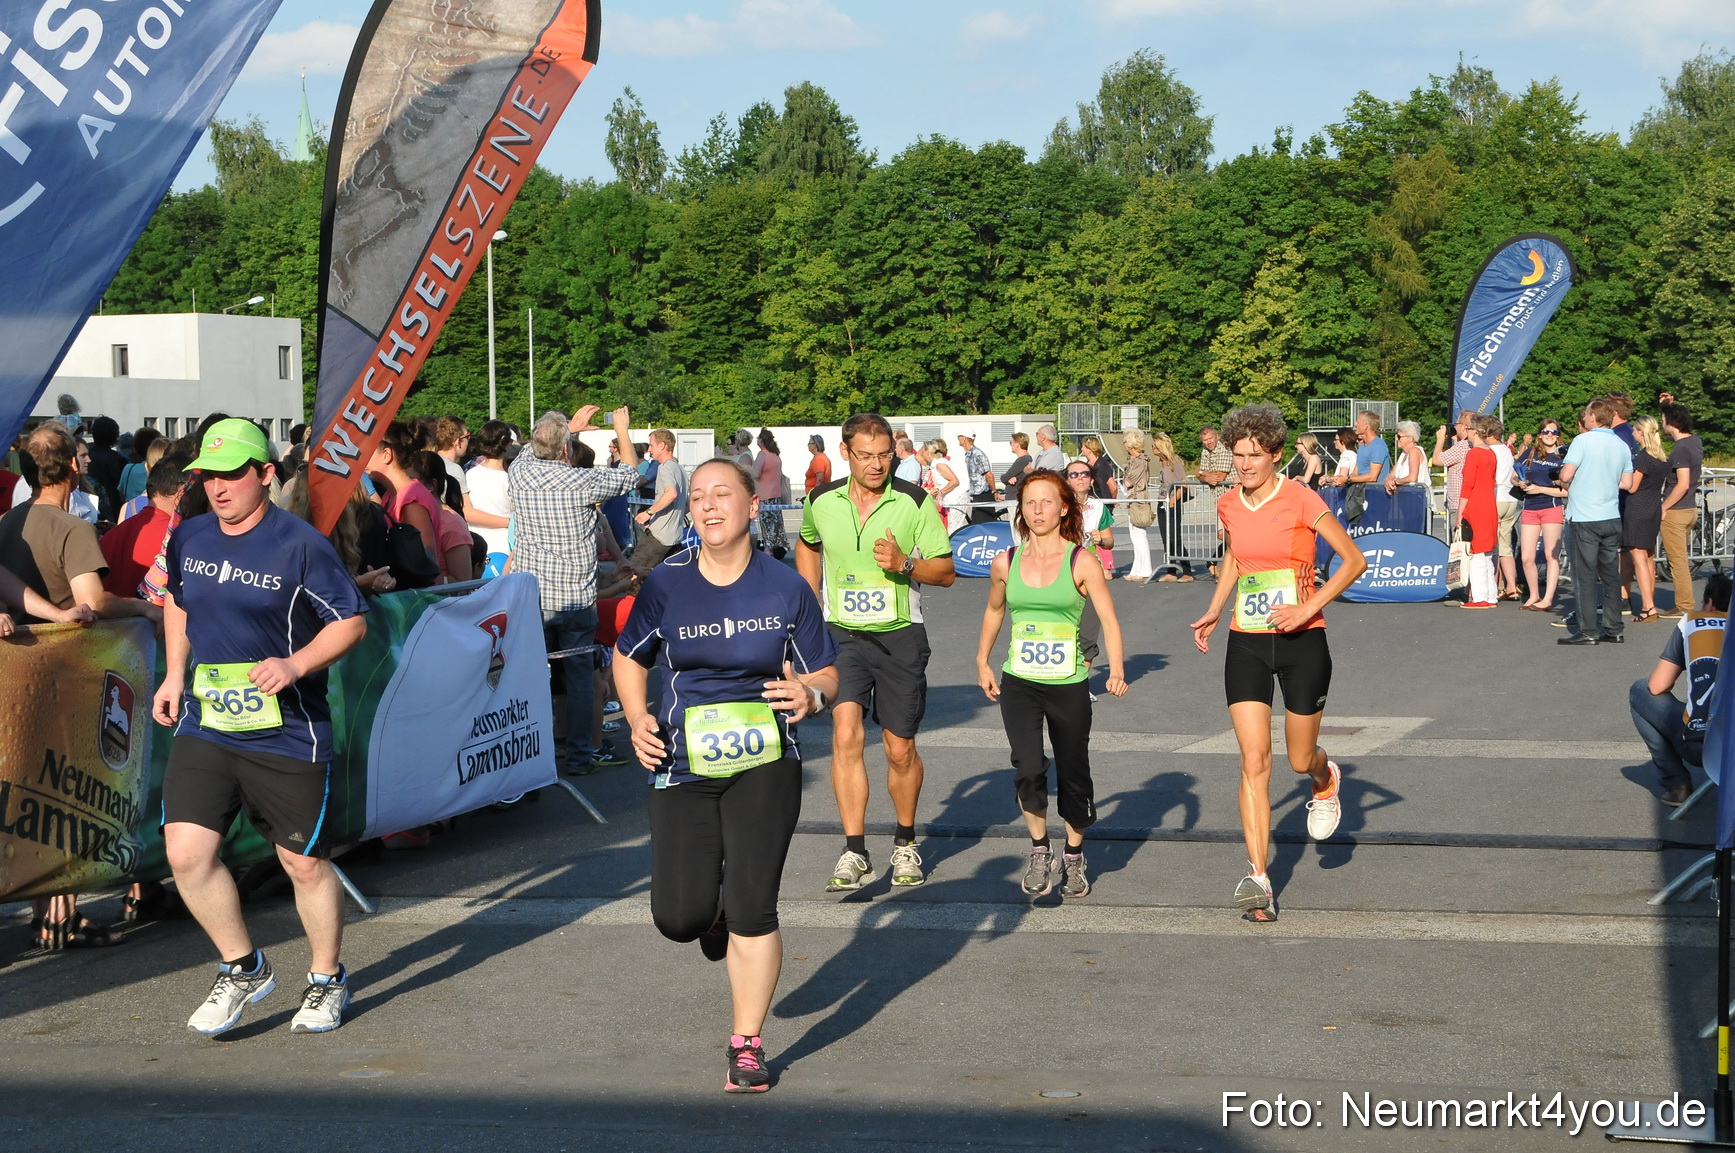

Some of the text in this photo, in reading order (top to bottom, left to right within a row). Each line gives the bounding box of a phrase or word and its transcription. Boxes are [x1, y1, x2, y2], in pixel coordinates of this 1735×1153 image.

[1515, 306, 1535, 329] Druck
[1460, 287, 1540, 387] Frischmann
[183, 557, 282, 590] EURO POLES
[1362, 562, 1443, 579] Fischer
[1369, 578, 1437, 587] AUTOMOBILE
[843, 590, 886, 613] 583
[1244, 590, 1284, 616] 584
[679, 616, 782, 640] EURO POLES
[1020, 642, 1065, 665] 585
[205, 687, 264, 715] 365
[468, 698, 529, 740] eumarkter
[457, 724, 540, 786] Lammsbräu
[701, 728, 765, 762] 330
[0, 780, 138, 873] Lammsb
